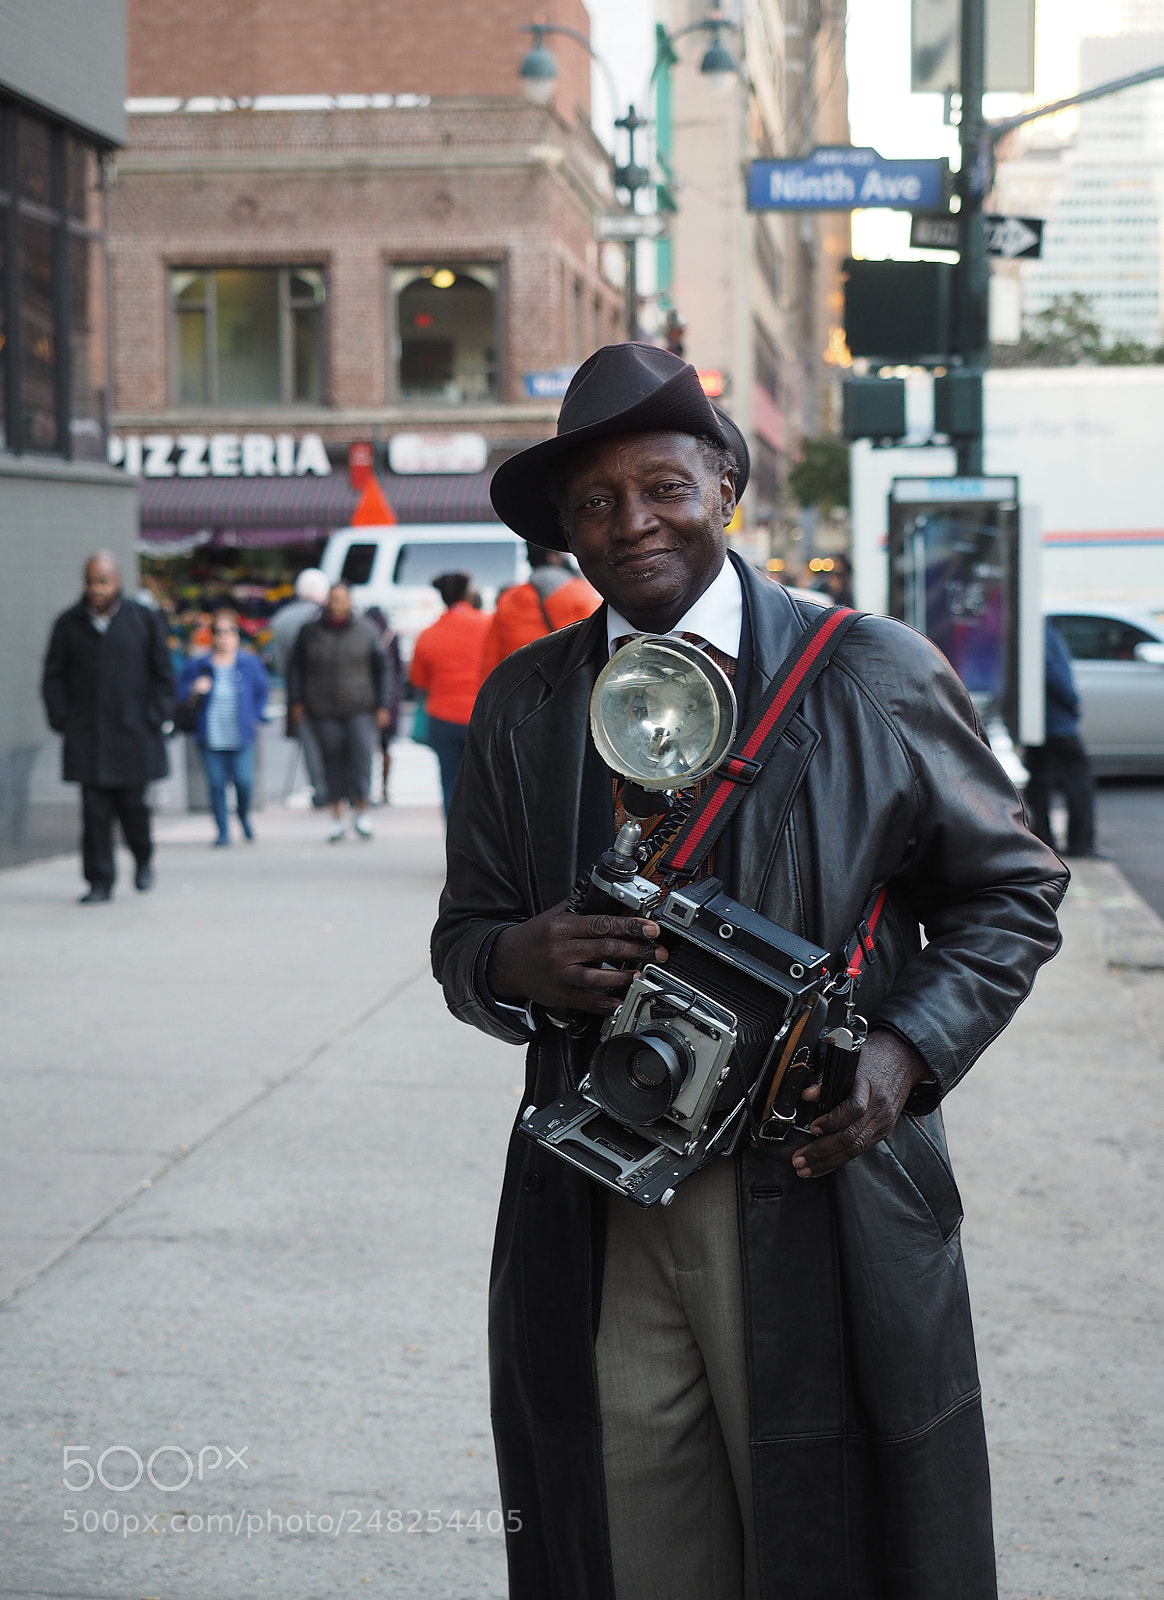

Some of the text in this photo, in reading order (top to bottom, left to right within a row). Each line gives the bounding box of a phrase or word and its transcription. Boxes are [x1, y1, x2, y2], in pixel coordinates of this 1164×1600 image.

[768, 167, 923, 201] Ninth Ave
[107, 433, 333, 478] PIZZERIA
